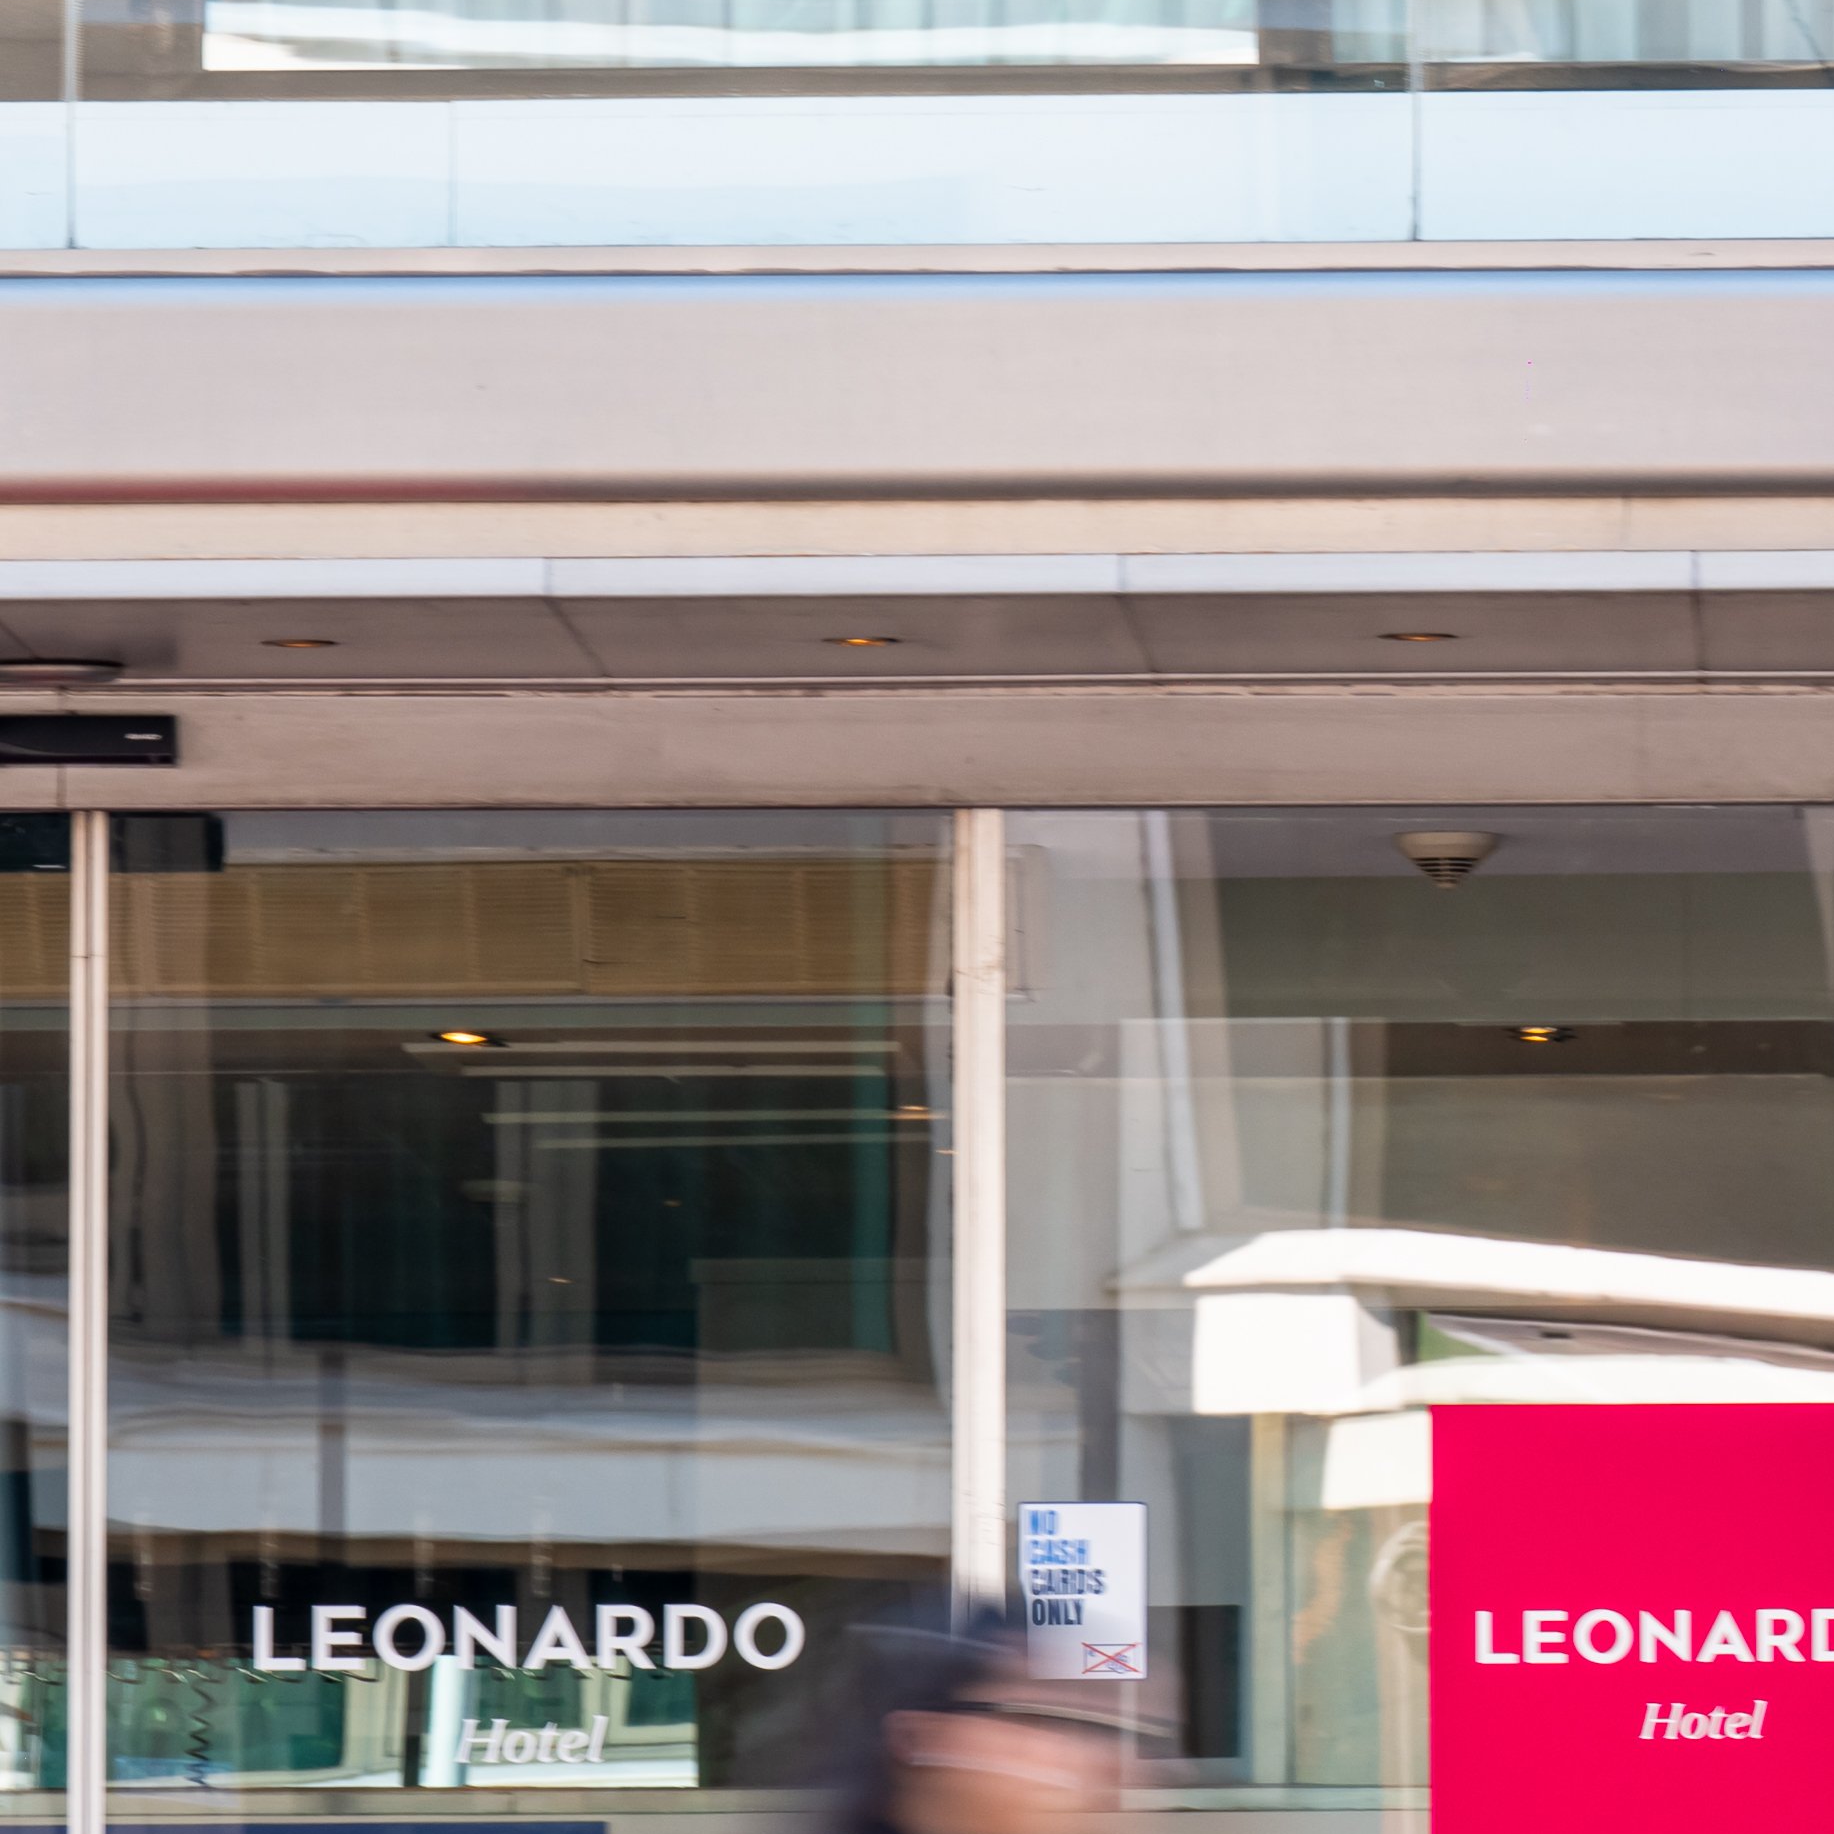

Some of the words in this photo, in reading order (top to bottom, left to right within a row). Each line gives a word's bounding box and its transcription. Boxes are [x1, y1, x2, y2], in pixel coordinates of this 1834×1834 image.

[1030, 1509, 1057, 1536] NO
[1030, 1539, 1090, 1565] CASH
[1031, 1569, 1105, 1596] CARDS
[1032, 1598, 1083, 1626] ONLY
[253, 1602, 806, 1672] LEONARDO
[1638, 1699, 1768, 1740] Hotel
[455, 1714, 608, 1765] Hotel
